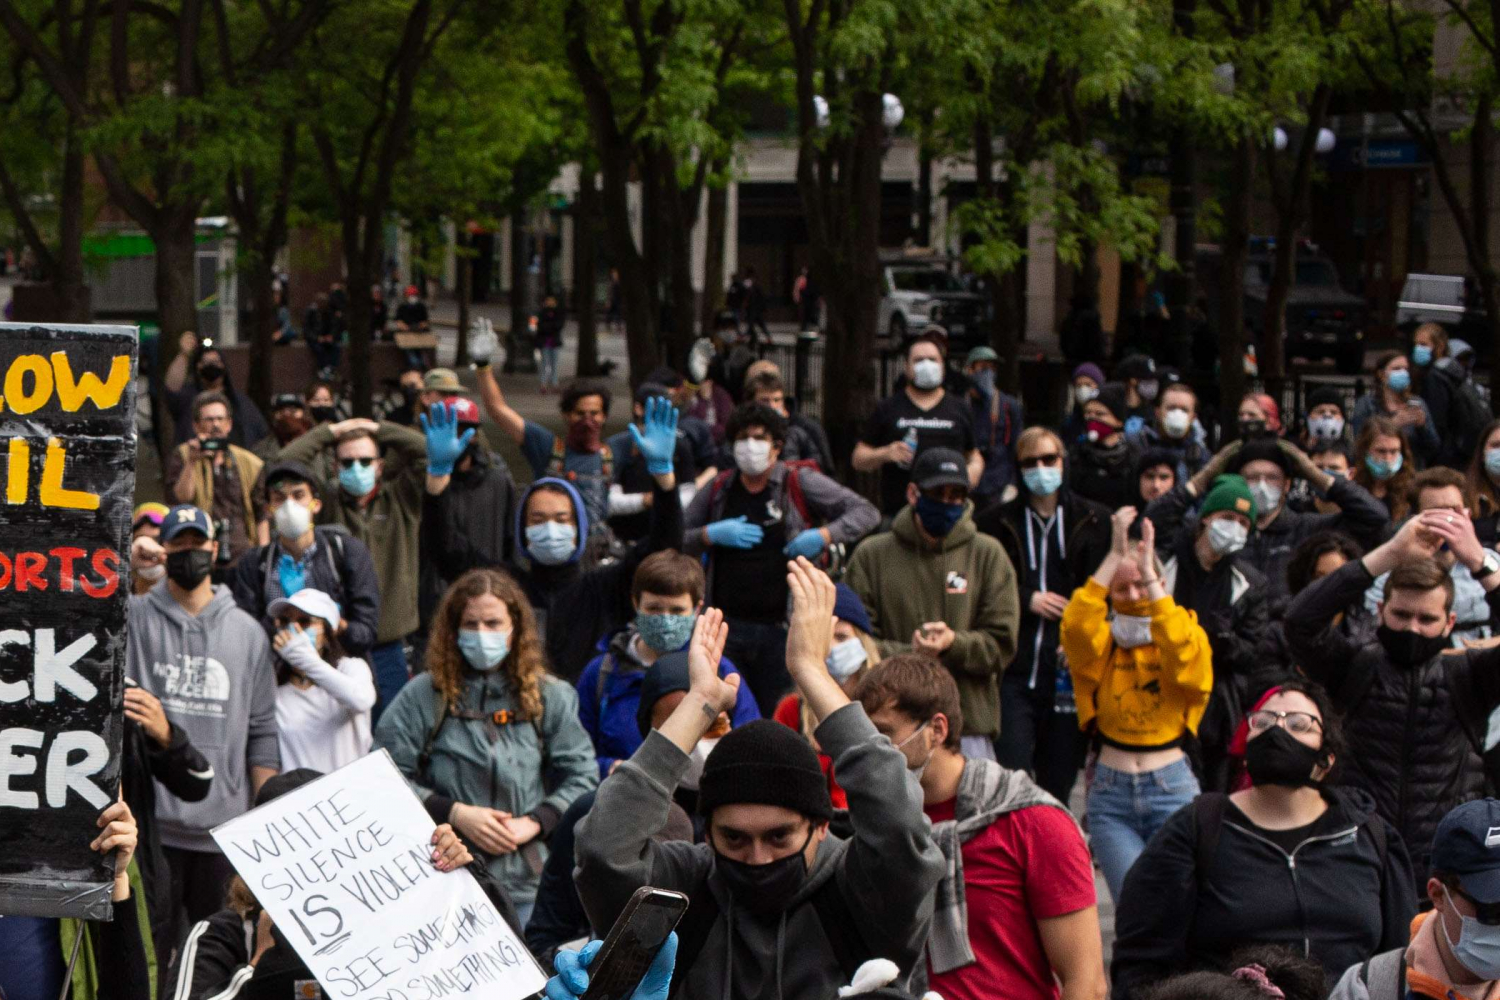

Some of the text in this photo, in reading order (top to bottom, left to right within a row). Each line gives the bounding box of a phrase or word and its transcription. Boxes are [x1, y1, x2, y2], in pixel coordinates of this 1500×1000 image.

[232, 788, 367, 863] WHITE
[261, 820, 394, 901] SILENCE
[288, 842, 438, 946] IS VIOLEN
[325, 946, 401, 997] SEE
